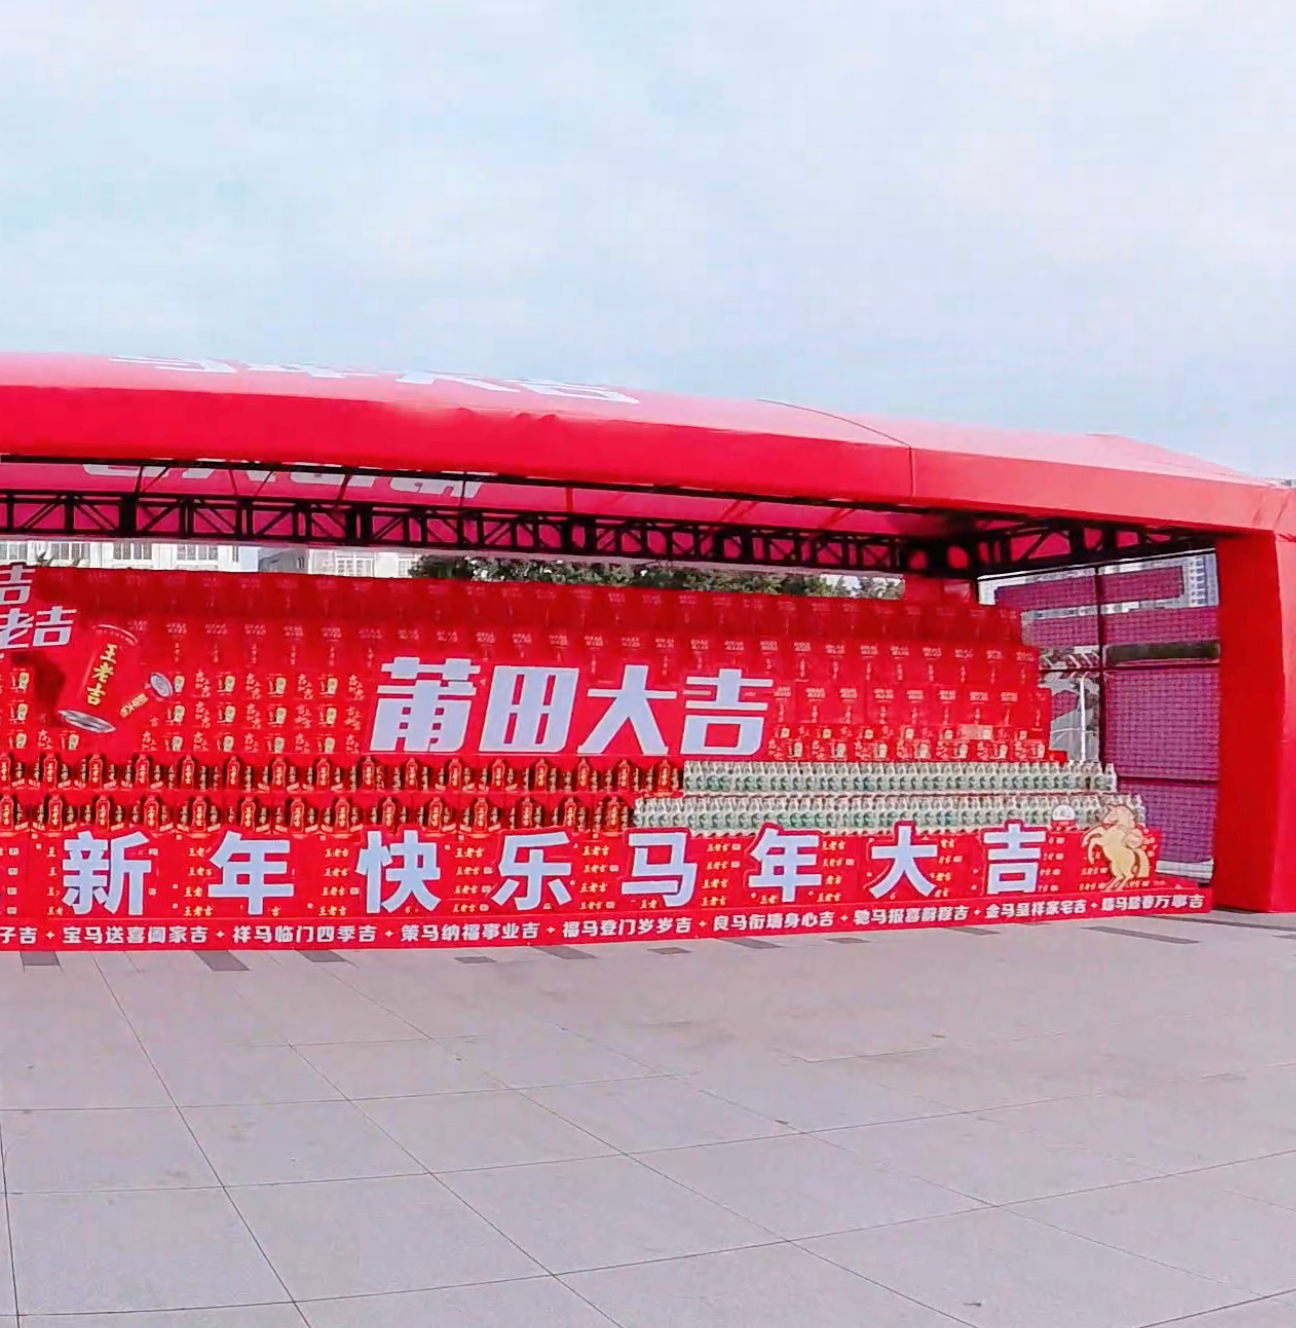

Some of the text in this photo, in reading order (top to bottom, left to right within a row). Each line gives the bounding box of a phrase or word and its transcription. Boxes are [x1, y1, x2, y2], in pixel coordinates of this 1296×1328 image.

[86, 643, 118, 706] 王老吉
[369, 656, 774, 755] 莆田大吉
[232, 924, 377, 944] 祥马临门四季吉
